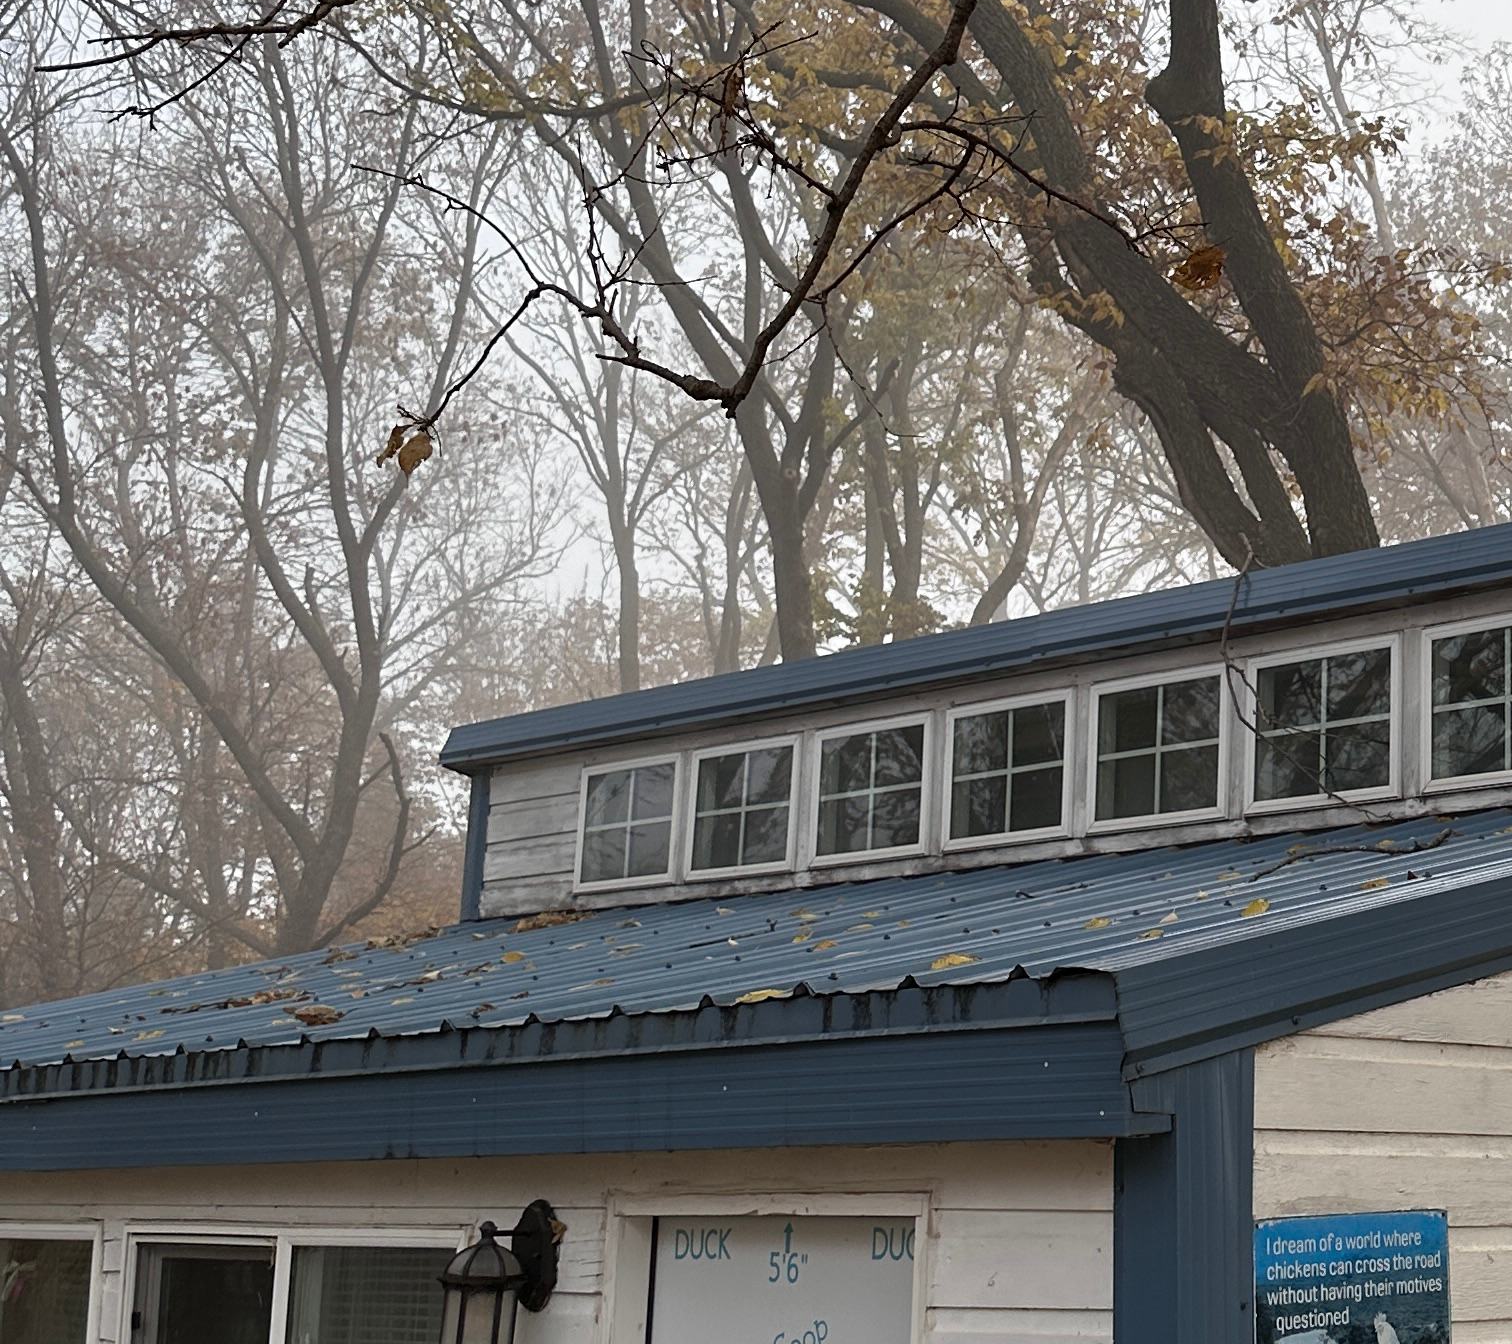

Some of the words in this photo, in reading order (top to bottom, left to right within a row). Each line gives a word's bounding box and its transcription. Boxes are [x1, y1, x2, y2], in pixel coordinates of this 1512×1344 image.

[674, 1227, 732, 1260] DUCK
[1265, 1237, 1270, 1255] I
[1273, 1236, 1317, 1255] dream
[1319, 1233, 1335, 1252] of
[1335, 1237, 1343, 1251] a
[1346, 1231, 1381, 1250] world
[1383, 1230, 1422, 1248] where
[1267, 1259, 1327, 1281] chickens
[1329, 1261, 1353, 1276] can
[1355, 1257, 1391, 1275] cross
[1392, 1254, 1413, 1271] the
[1414, 1250, 1442, 1269] road
[1267, 1283, 1318, 1306] without
[1320, 1281, 1362, 1302] having
[1364, 1279, 1392, 1298] their
[1396, 1276, 1442, 1295] motives
[1275, 1306, 1350, 1335] questioned
